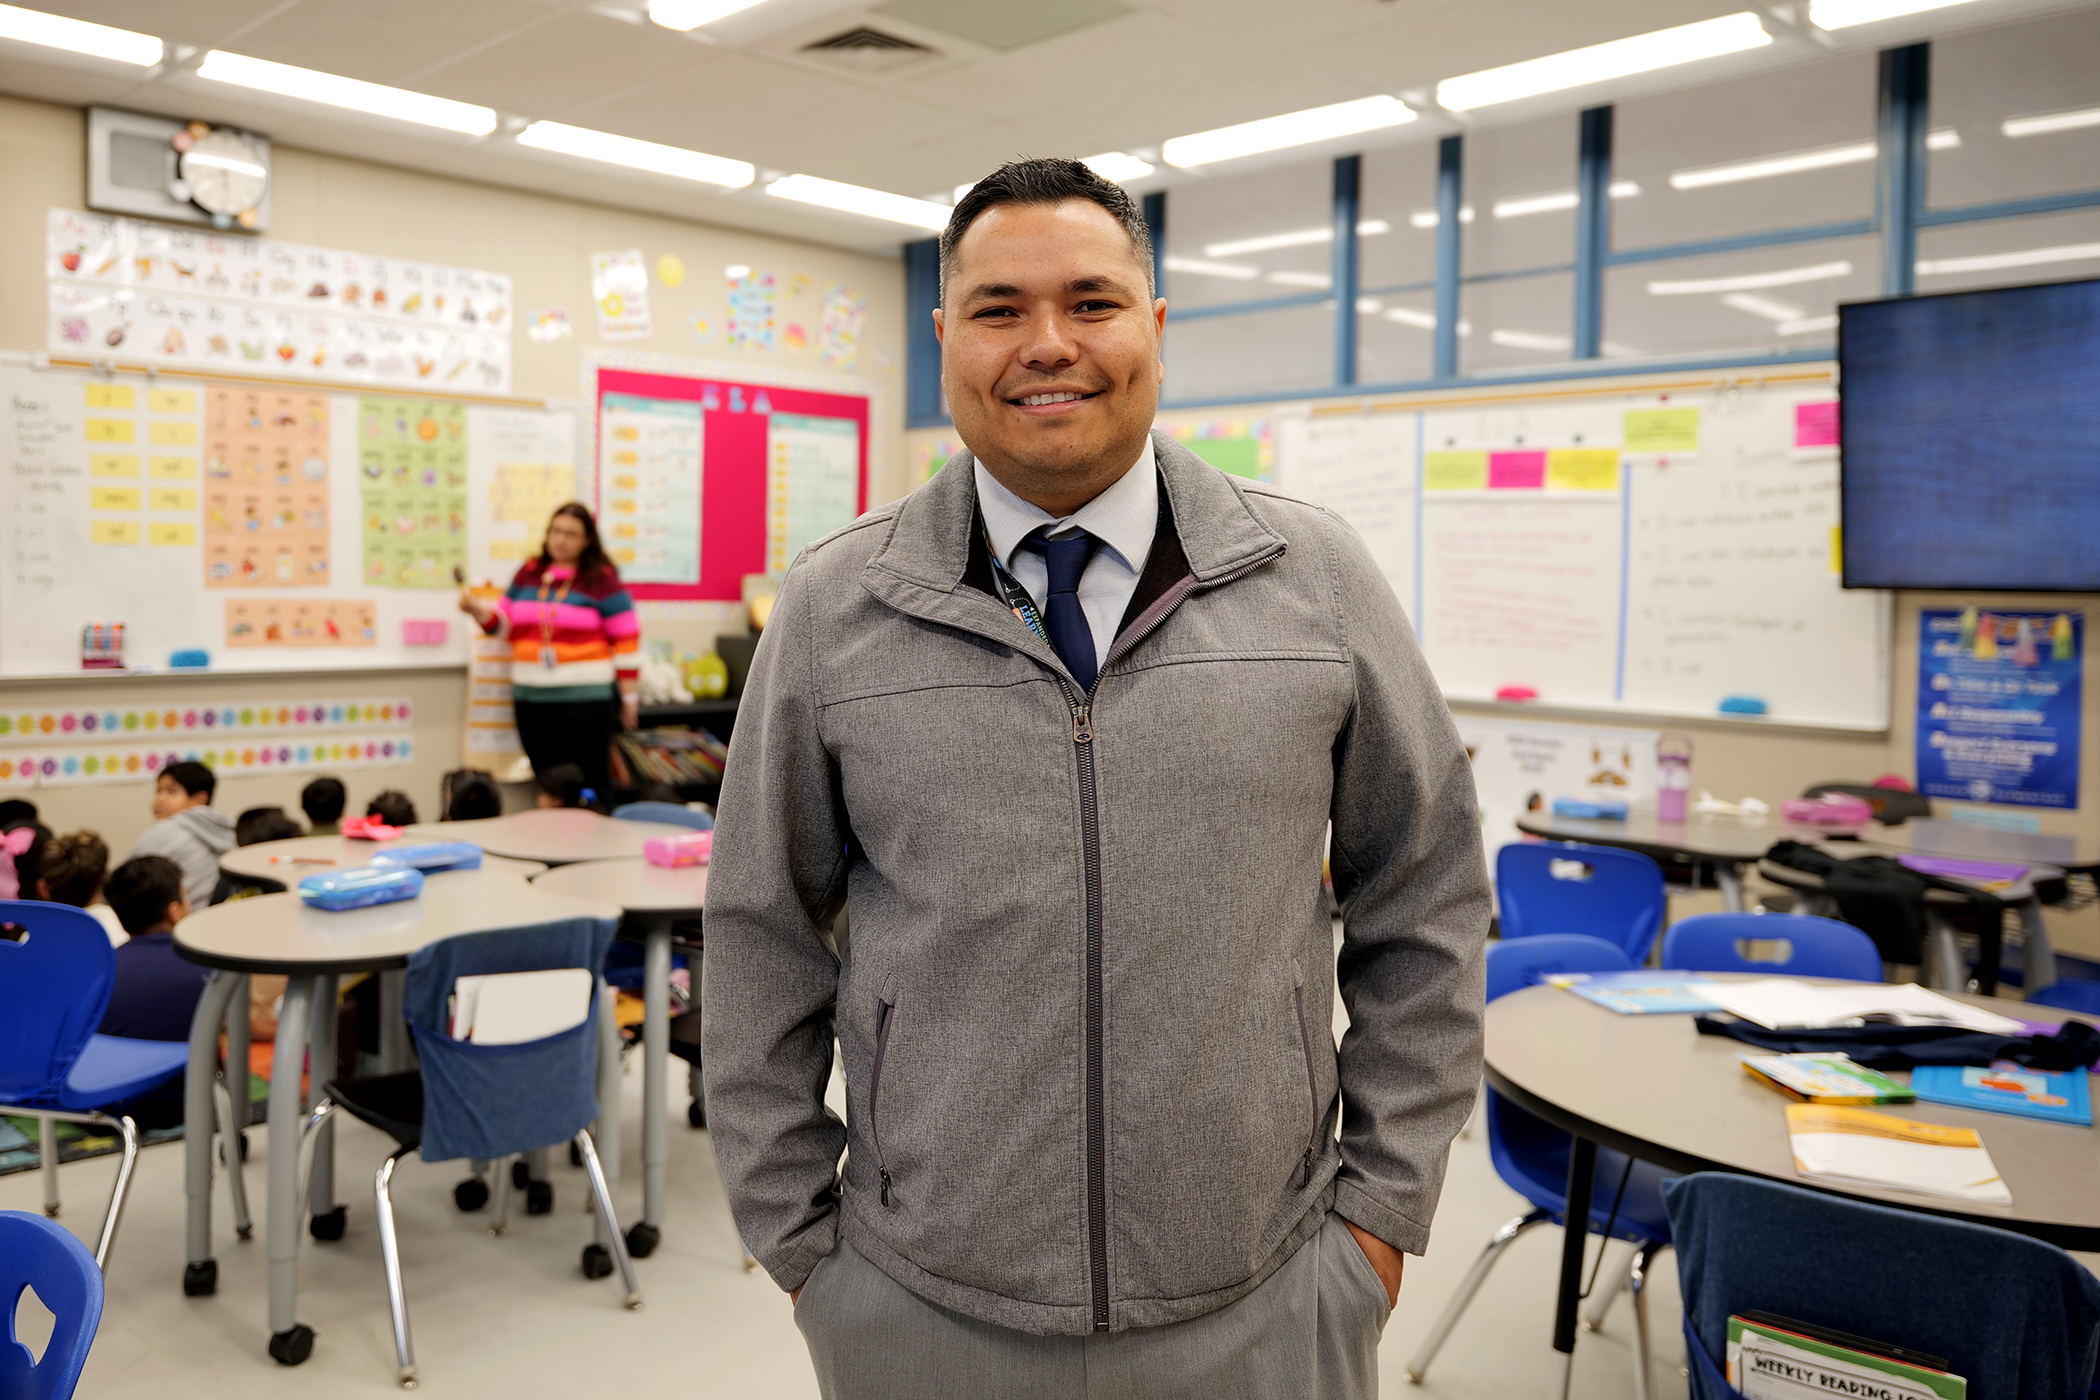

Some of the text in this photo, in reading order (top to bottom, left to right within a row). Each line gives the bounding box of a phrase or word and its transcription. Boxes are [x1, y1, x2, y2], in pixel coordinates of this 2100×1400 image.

[1031, 610, 1049, 645] EXPANDED
[1755, 1356, 1892, 1400] WEEKLY READING
